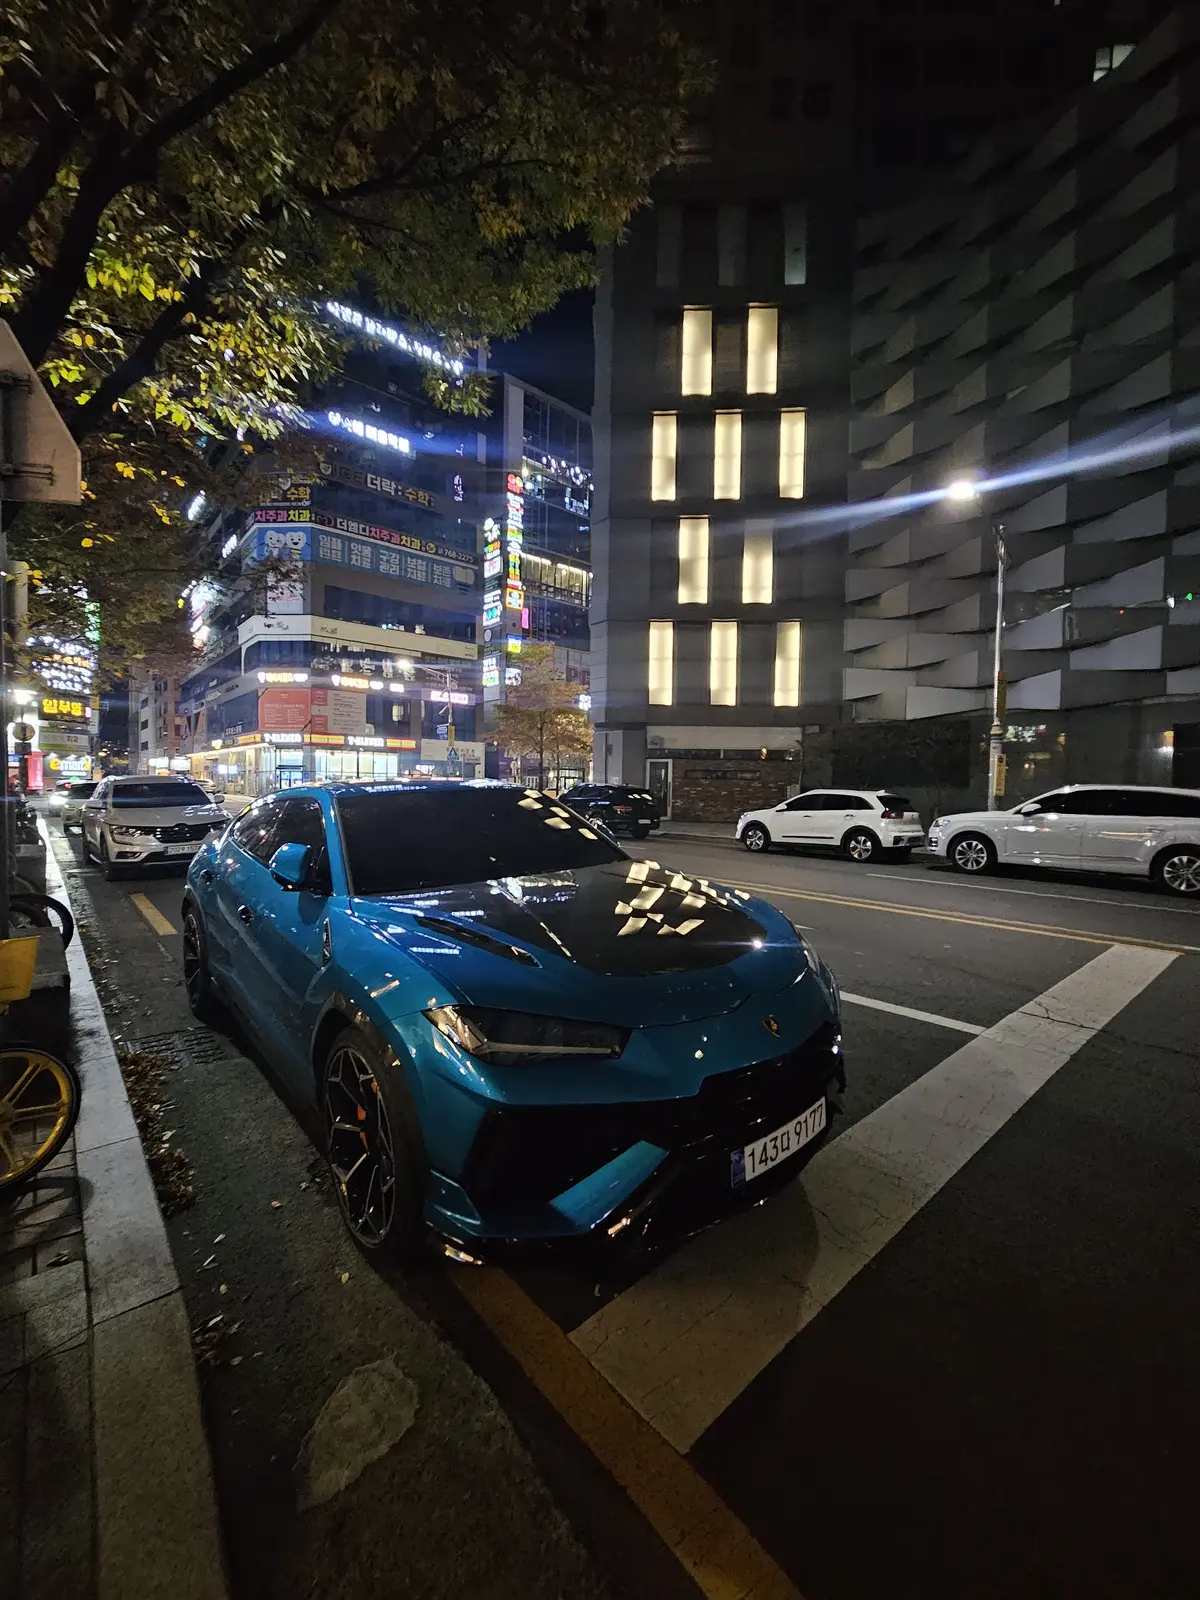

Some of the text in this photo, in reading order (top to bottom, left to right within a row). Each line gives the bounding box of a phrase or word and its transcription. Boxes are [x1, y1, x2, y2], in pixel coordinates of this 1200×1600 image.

[287, 486, 311, 501] 수학
[404, 487, 429, 507] 수학
[255, 509, 311, 522] 치주과치과
[747, 1102, 823, 1174] 143다 9177
